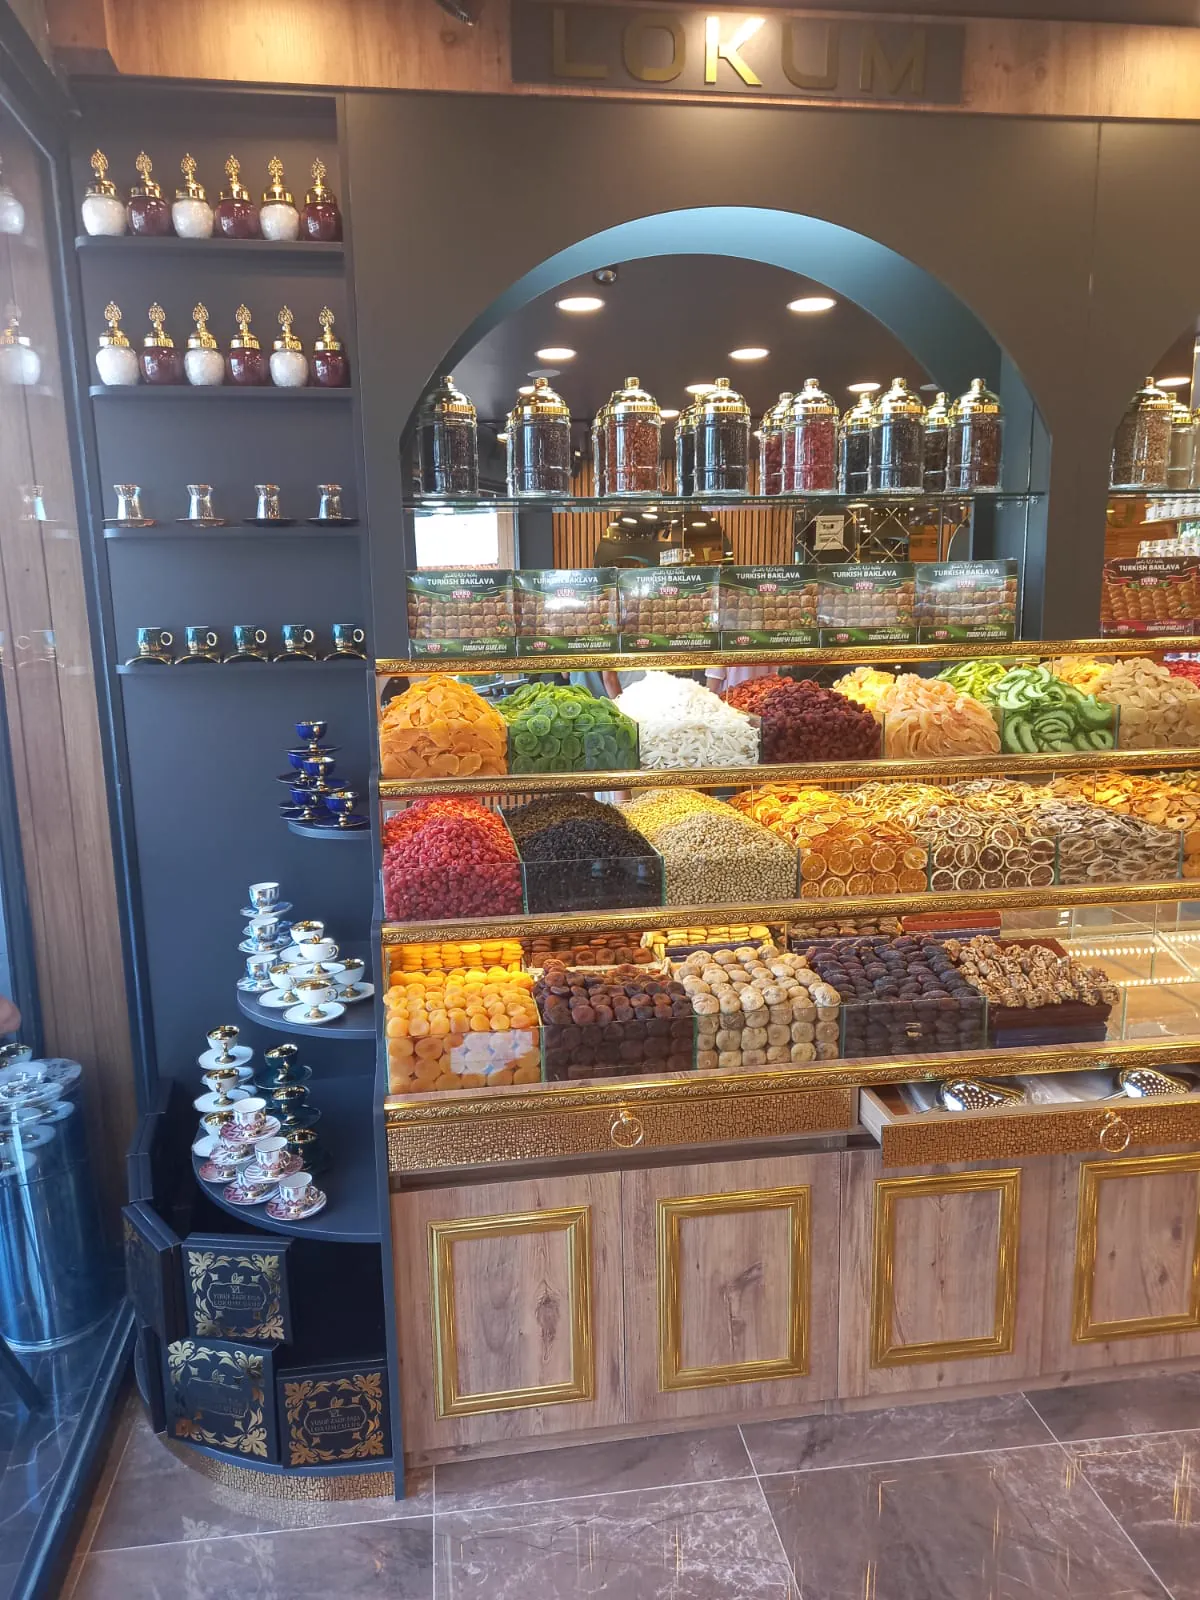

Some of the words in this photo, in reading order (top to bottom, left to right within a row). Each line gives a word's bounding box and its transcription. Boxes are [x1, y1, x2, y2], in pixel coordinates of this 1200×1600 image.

[552, 9, 926, 96] LOKUM
[427, 578, 459, 586] TURKISH
[667, 574, 702, 582] BAKLAVA
